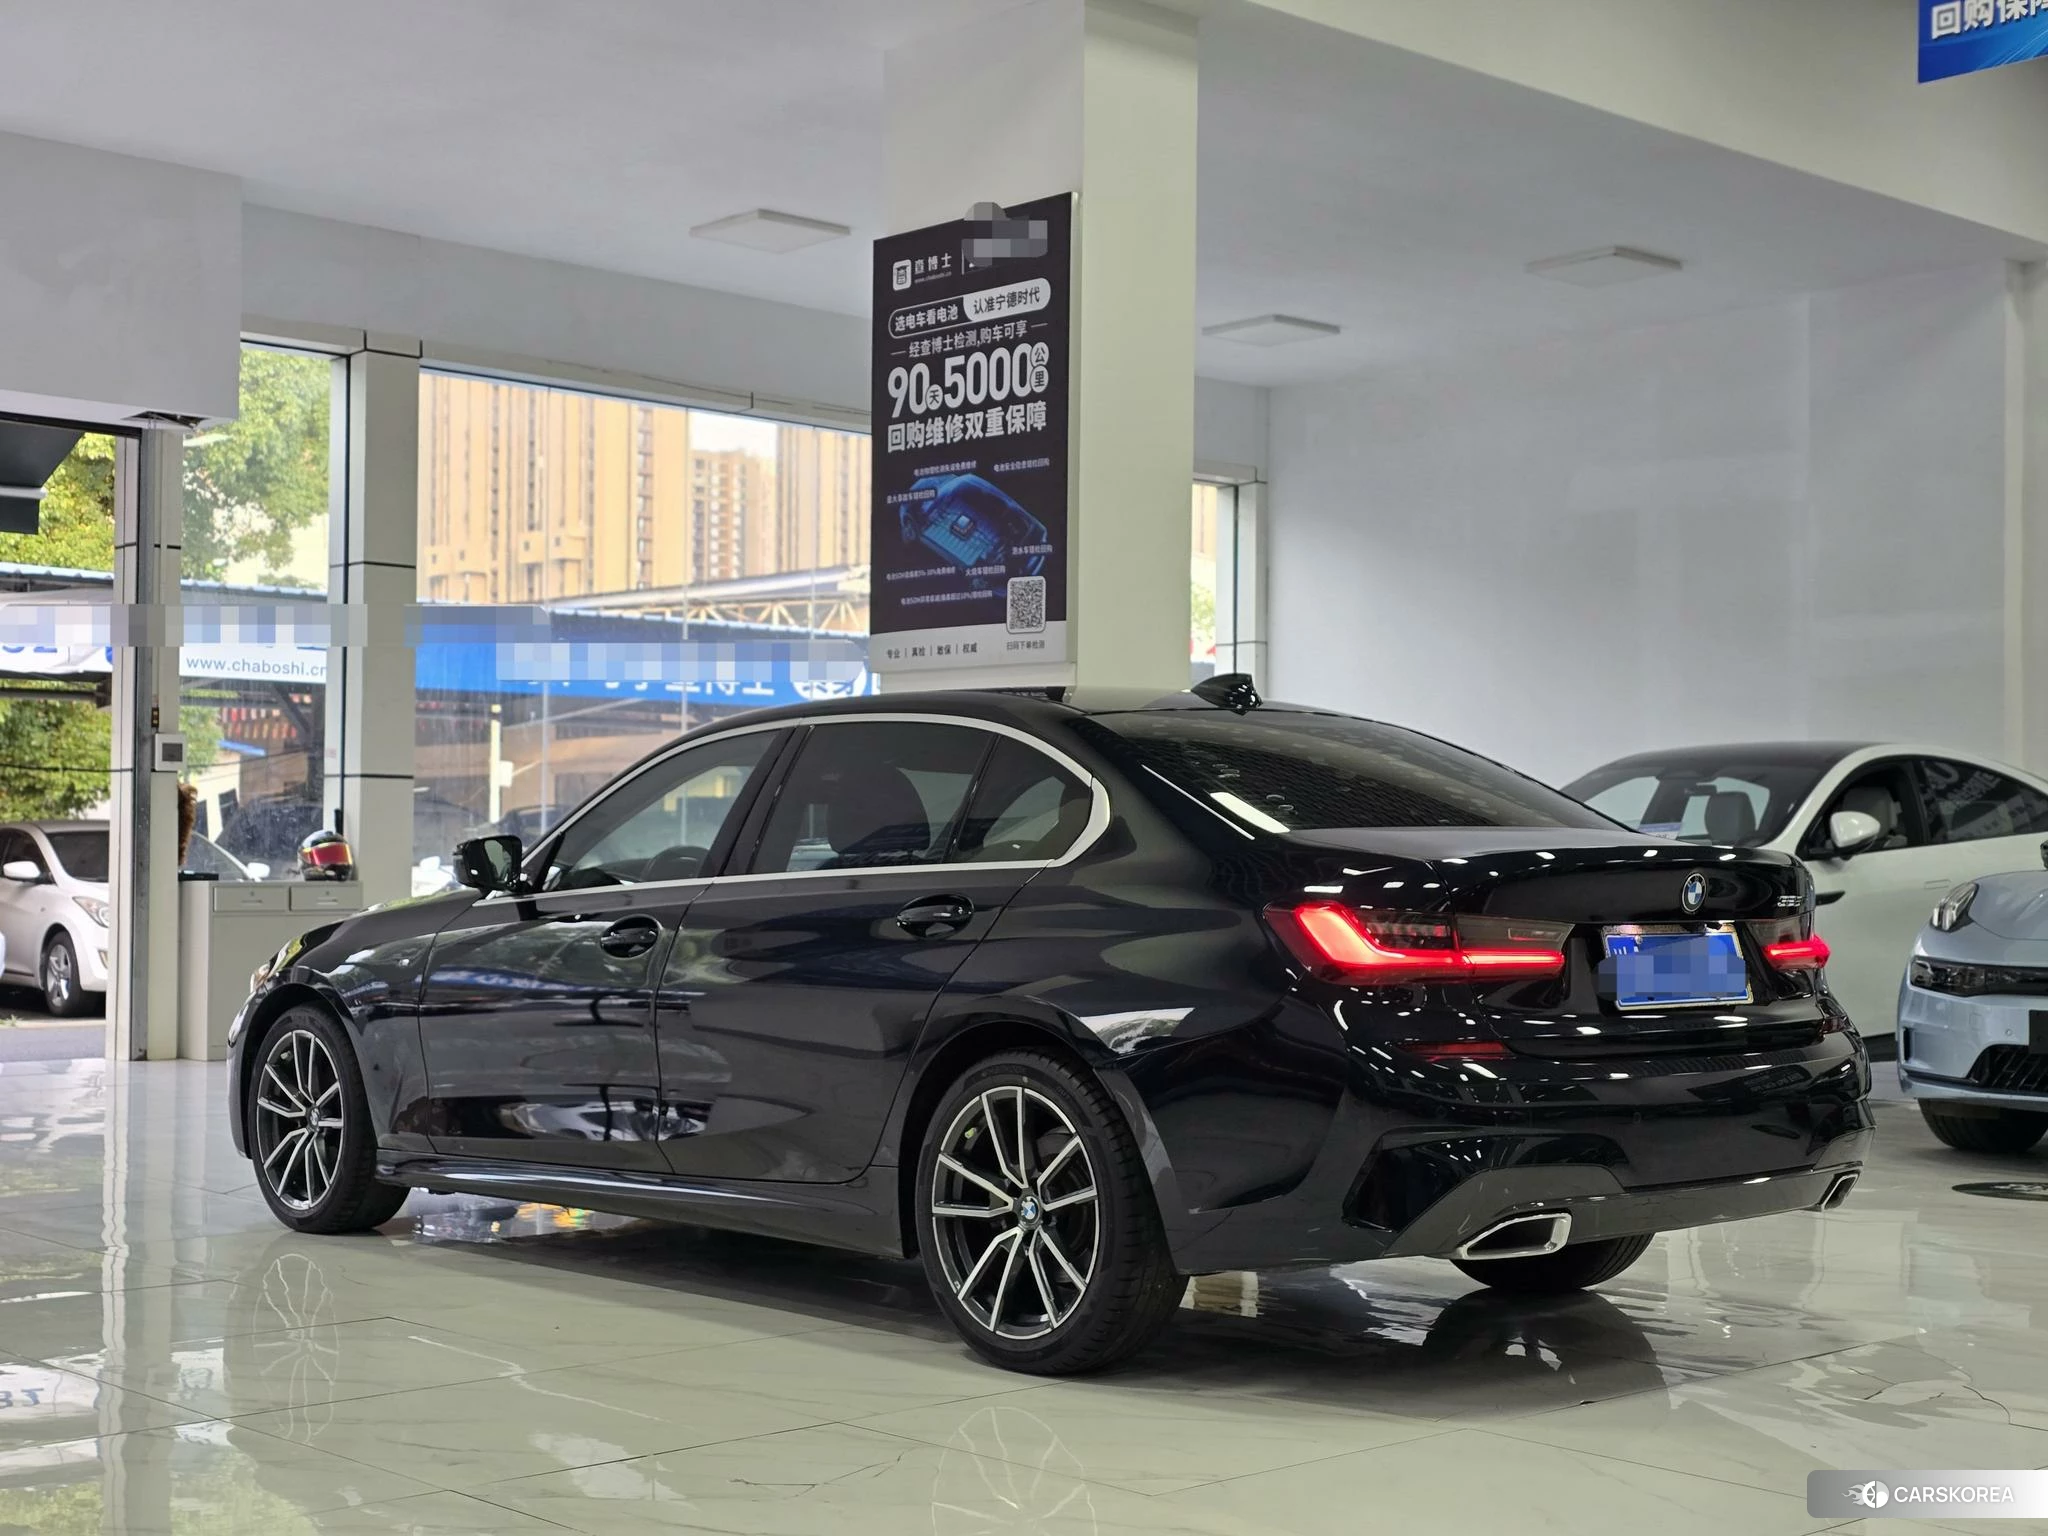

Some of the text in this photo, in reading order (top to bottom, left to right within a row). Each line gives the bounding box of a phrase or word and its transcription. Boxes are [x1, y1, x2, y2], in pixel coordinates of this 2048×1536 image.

[1931, 0, 2048, 39] 回购保
[894, 286, 1040, 332] 选电车看电池 认准宁德时代
[887, 400, 1047, 453] 回购维修双重保障
